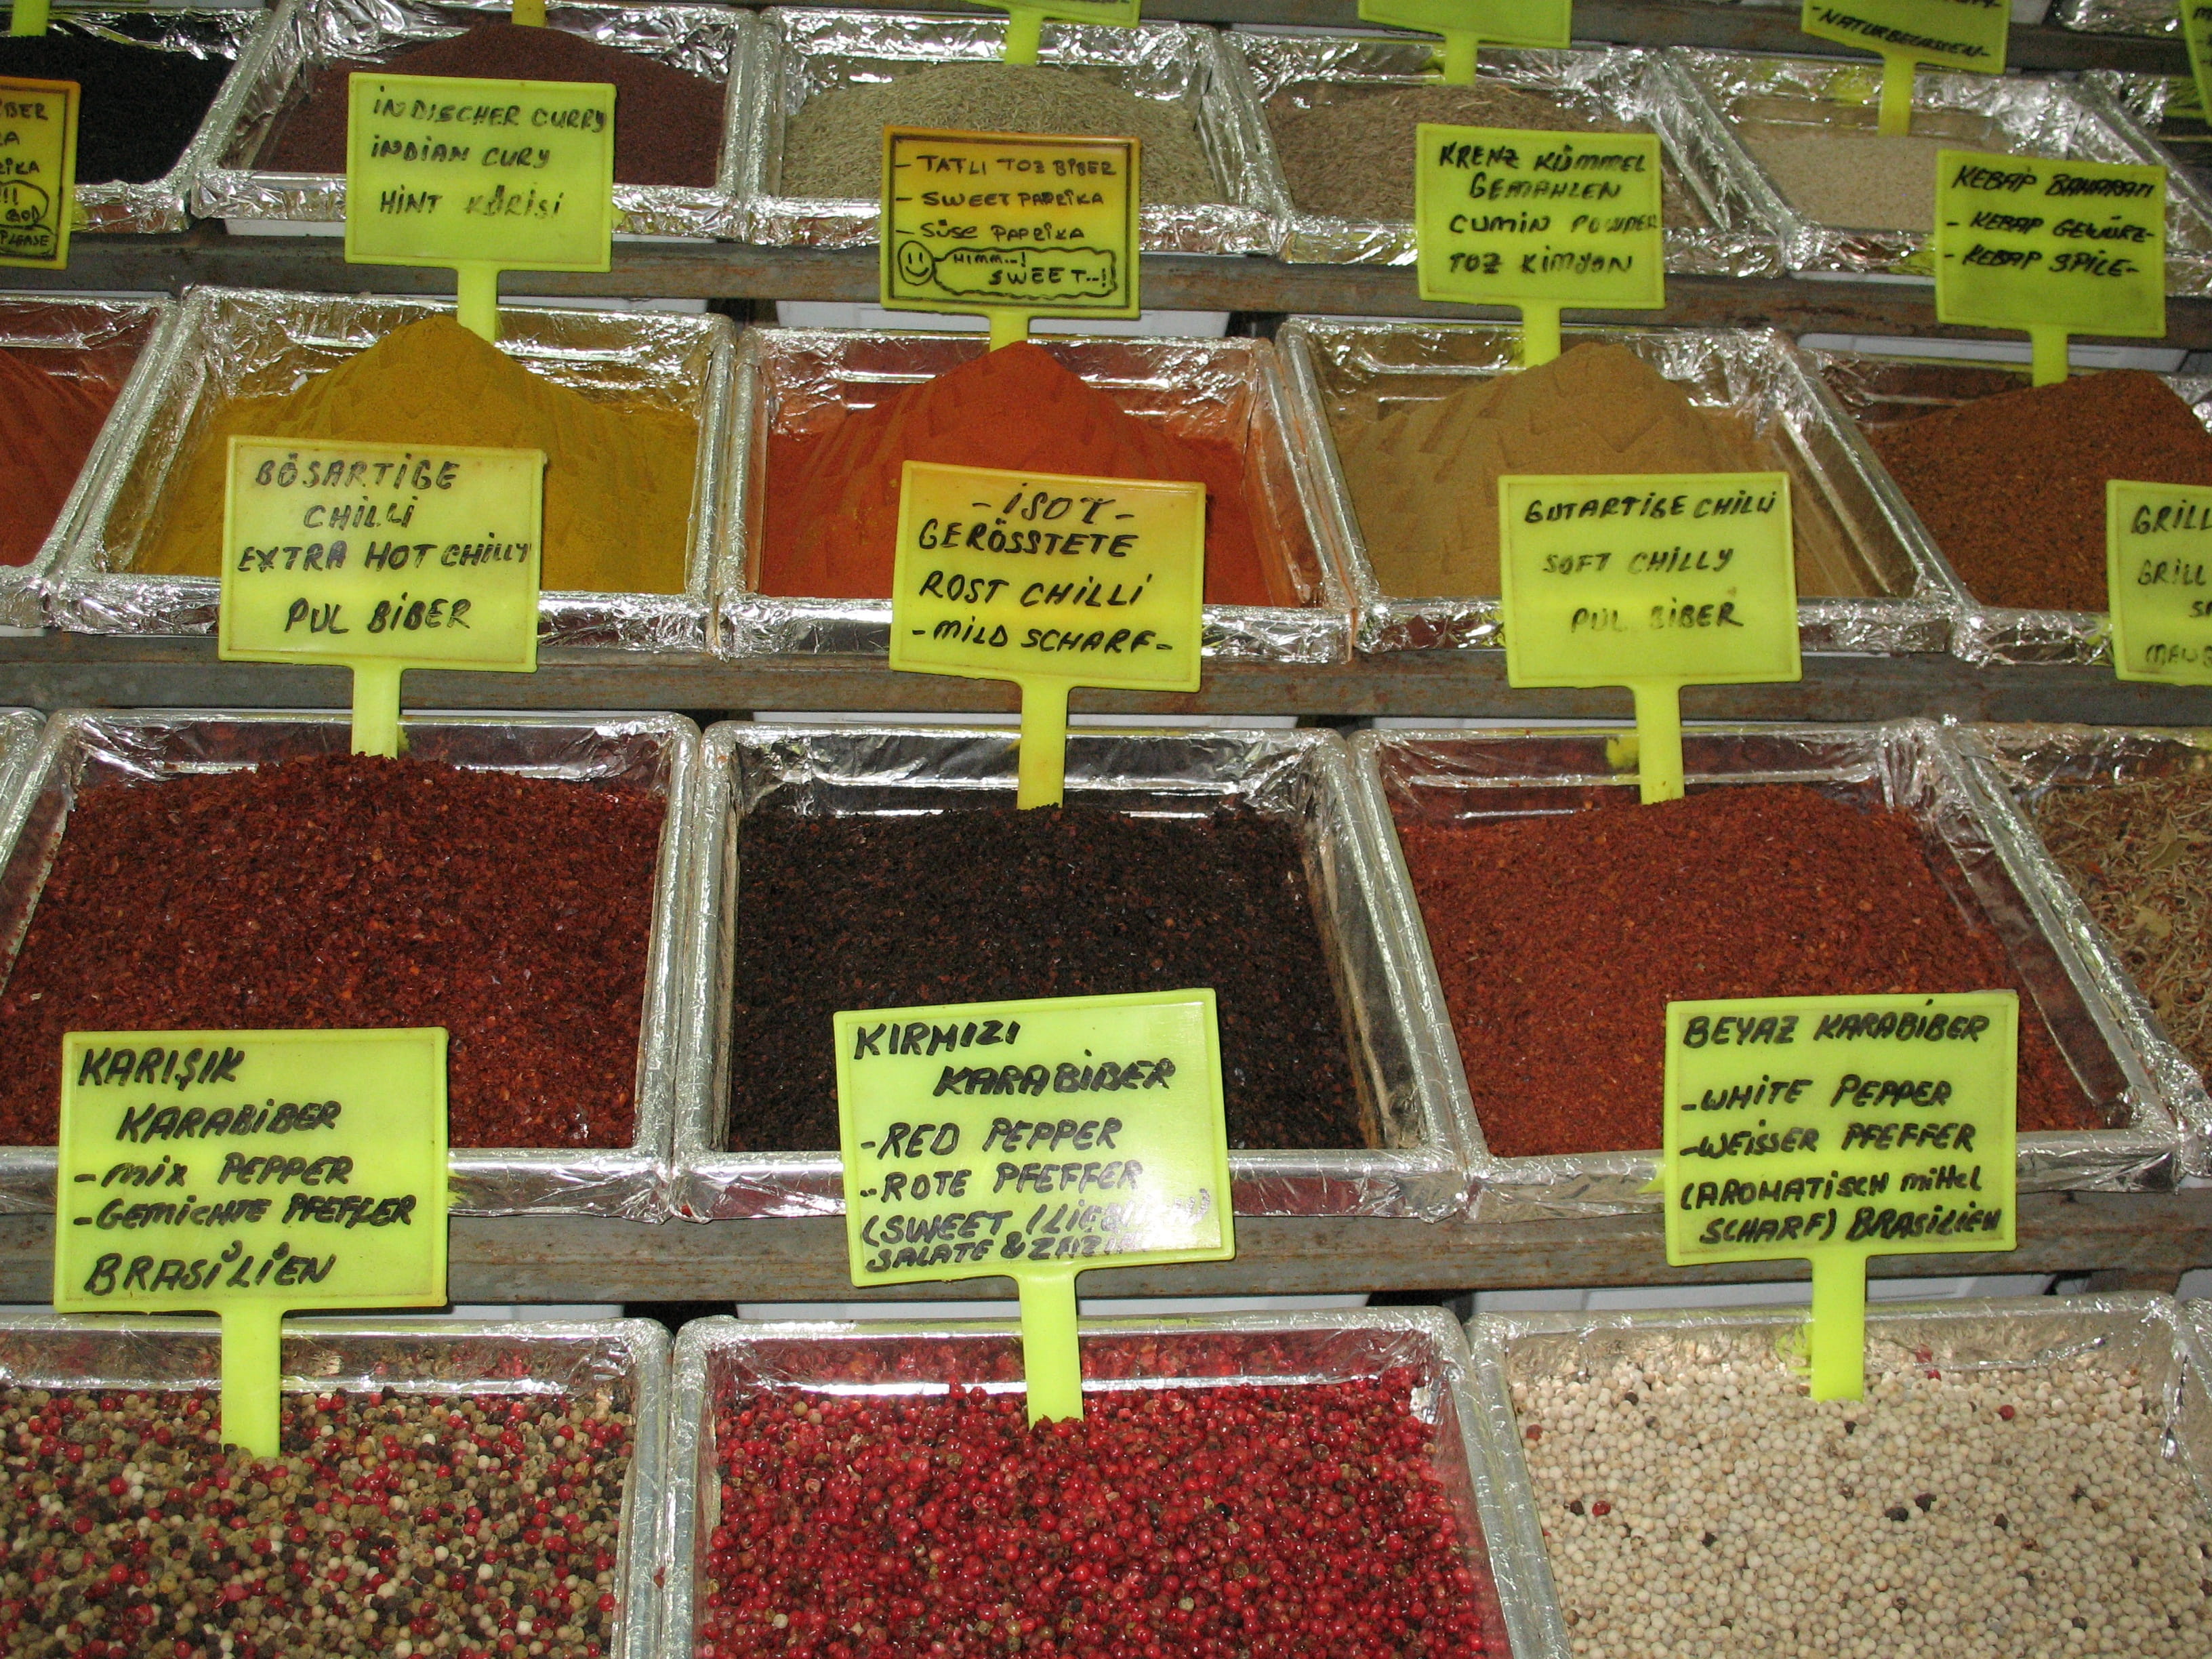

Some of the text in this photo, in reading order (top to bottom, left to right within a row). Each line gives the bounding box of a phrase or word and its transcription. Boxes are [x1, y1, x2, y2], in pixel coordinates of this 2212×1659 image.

[532, 108, 607, 132] CURRY
[482, 146, 551, 168] CURY
[997, 158, 1046, 174] TOZ
[921, 190, 1011, 207] SWEET
[1450, 251, 1504, 274] TOZ
[237, 539, 349, 573] EXTRA
[365, 541, 438, 572] HOT
[1542, 551, 1613, 576] SOFT
[919, 570, 1010, 605] ROST
[284, 597, 351, 634] PUL
[1571, 607, 1629, 634] PUL
[854, 1020, 1021, 1061] KIRMIZI
[1683, 1015, 1799, 1049] BEYAZ
[1830, 1073, 1952, 1108] PEPPER
[982, 1116, 1123, 1153] PEPPER
[1842, 1122, 1976, 1153] PFEFFER
[218, 1151, 354, 1187] PEPPER
[992, 1159, 1143, 1193] PFEFFER
[865, 1239, 994, 1273] SALATE
